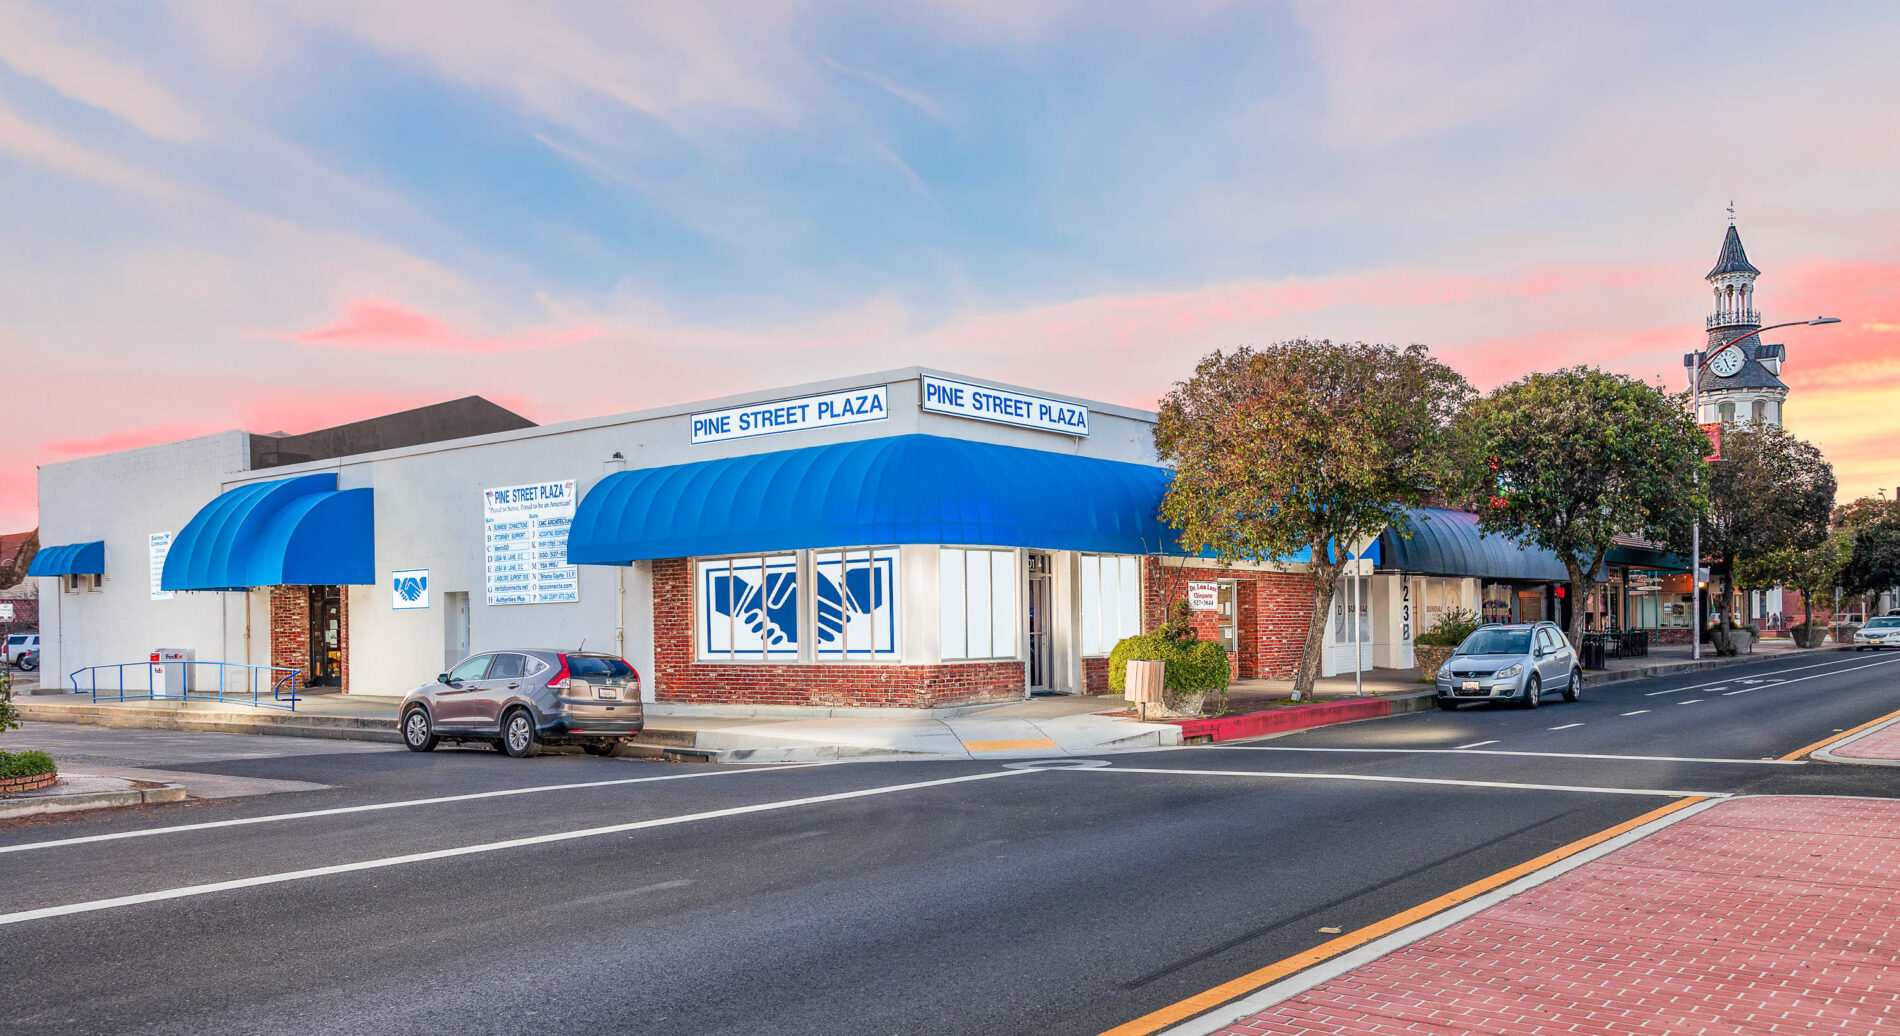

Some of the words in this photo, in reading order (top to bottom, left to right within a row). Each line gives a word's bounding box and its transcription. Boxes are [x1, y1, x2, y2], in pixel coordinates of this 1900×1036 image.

[694, 414, 731, 438] PINE
[738, 404, 810, 434] STREET
[818, 394, 884, 421] PLAZA
[926, 382, 966, 407] PINE
[971, 391, 1033, 419] STREET
[1039, 404, 1086, 428] PLAZA
[494, 490, 510, 504] PINE
[512, 487, 538, 502] STREET
[540, 484, 564, 500] PLAZA
